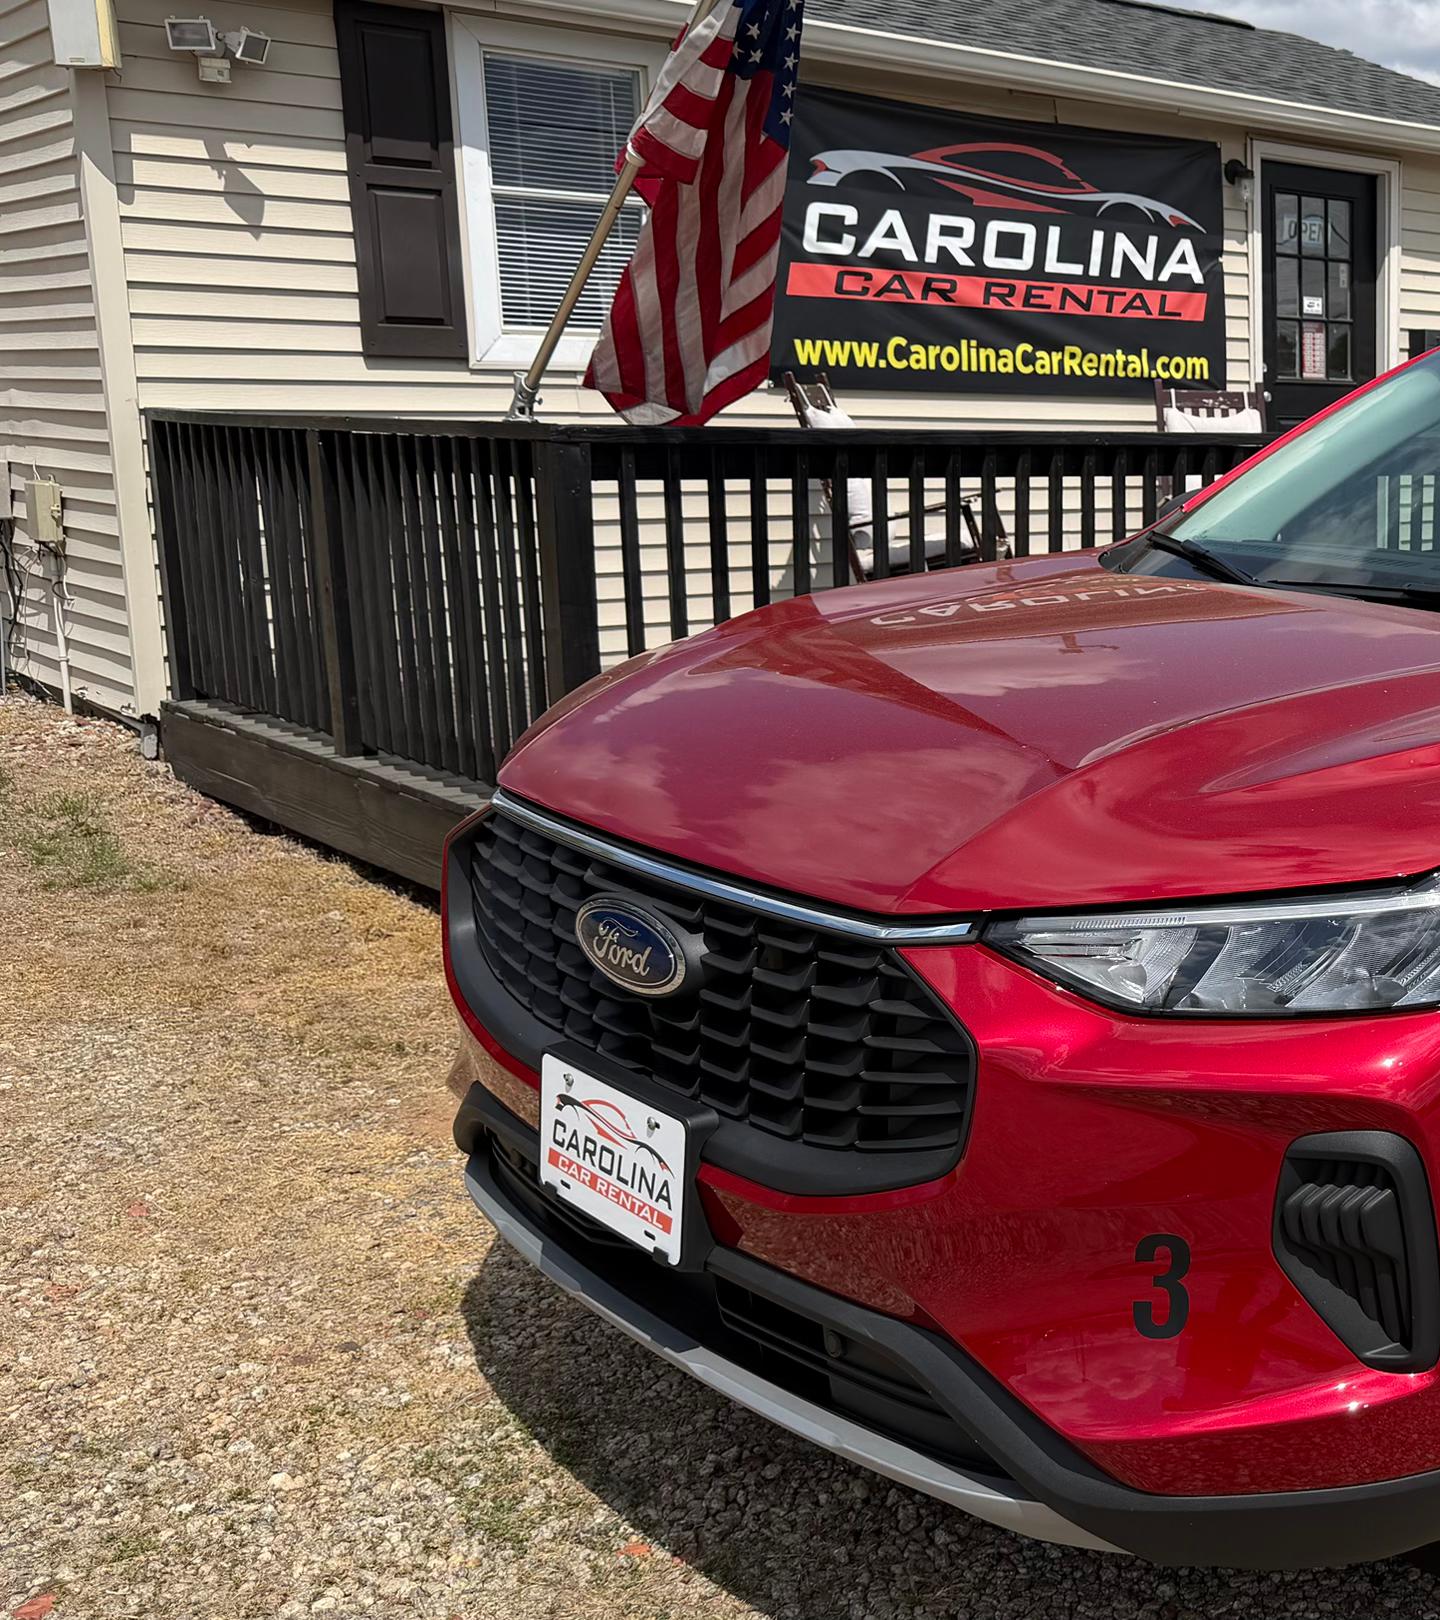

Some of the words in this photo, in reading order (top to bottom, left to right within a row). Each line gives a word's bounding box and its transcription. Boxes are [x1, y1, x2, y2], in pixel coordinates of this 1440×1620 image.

[803, 202, 1204, 284] CAROLINA
[834, 270, 958, 303] CAR
[983, 281, 1182, 317] RENTAL
[793, 336, 1210, 381] www.CarolinaCarRental.com
[593, 916, 653, 976] Ford
[553, 1118, 672, 1211] CAROLINA
[558, 1155, 590, 1186] CAR
[595, 1178, 664, 1229] RENTAL
[1132, 1232, 1191, 1340] 3
